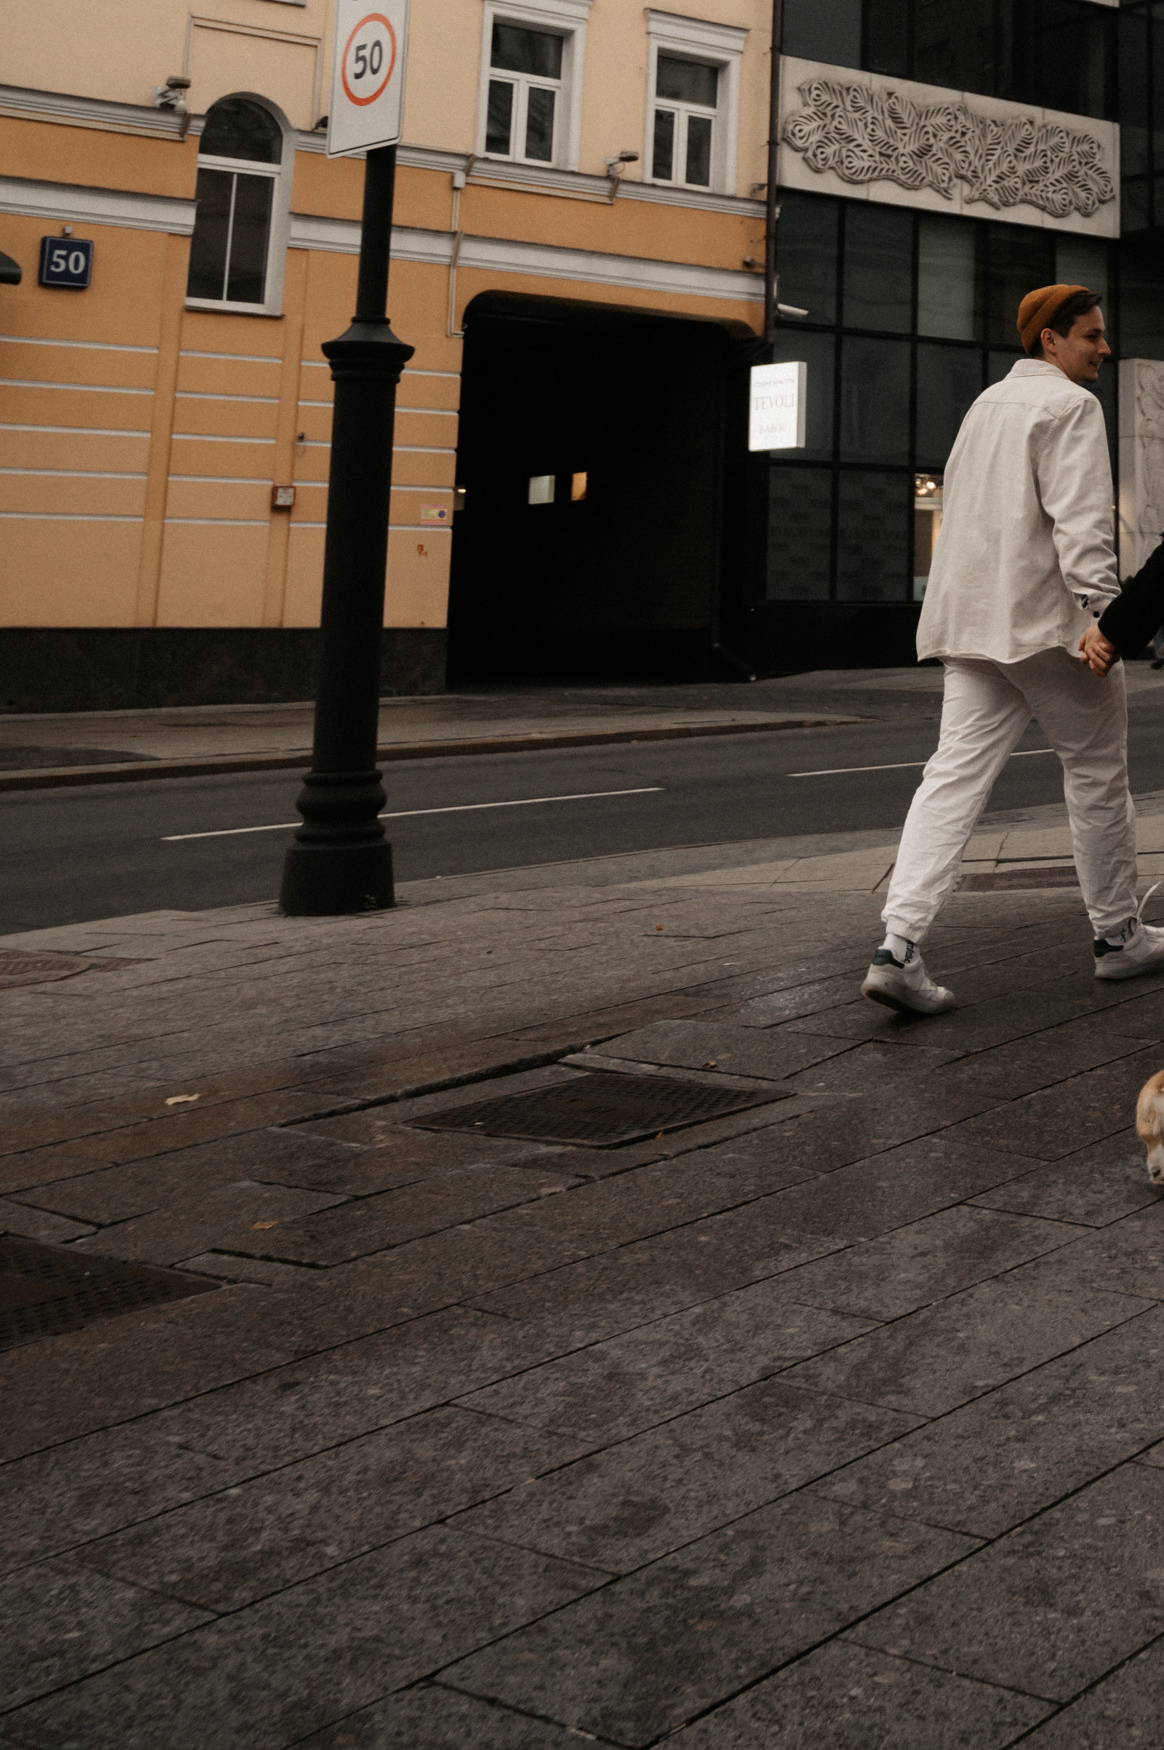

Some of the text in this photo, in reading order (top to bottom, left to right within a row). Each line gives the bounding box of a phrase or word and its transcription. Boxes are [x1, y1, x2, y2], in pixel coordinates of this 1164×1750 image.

[353, 39, 383, 80] 50
[50, 249, 86, 274] 50
[753, 394, 795, 411] TEVOLI
